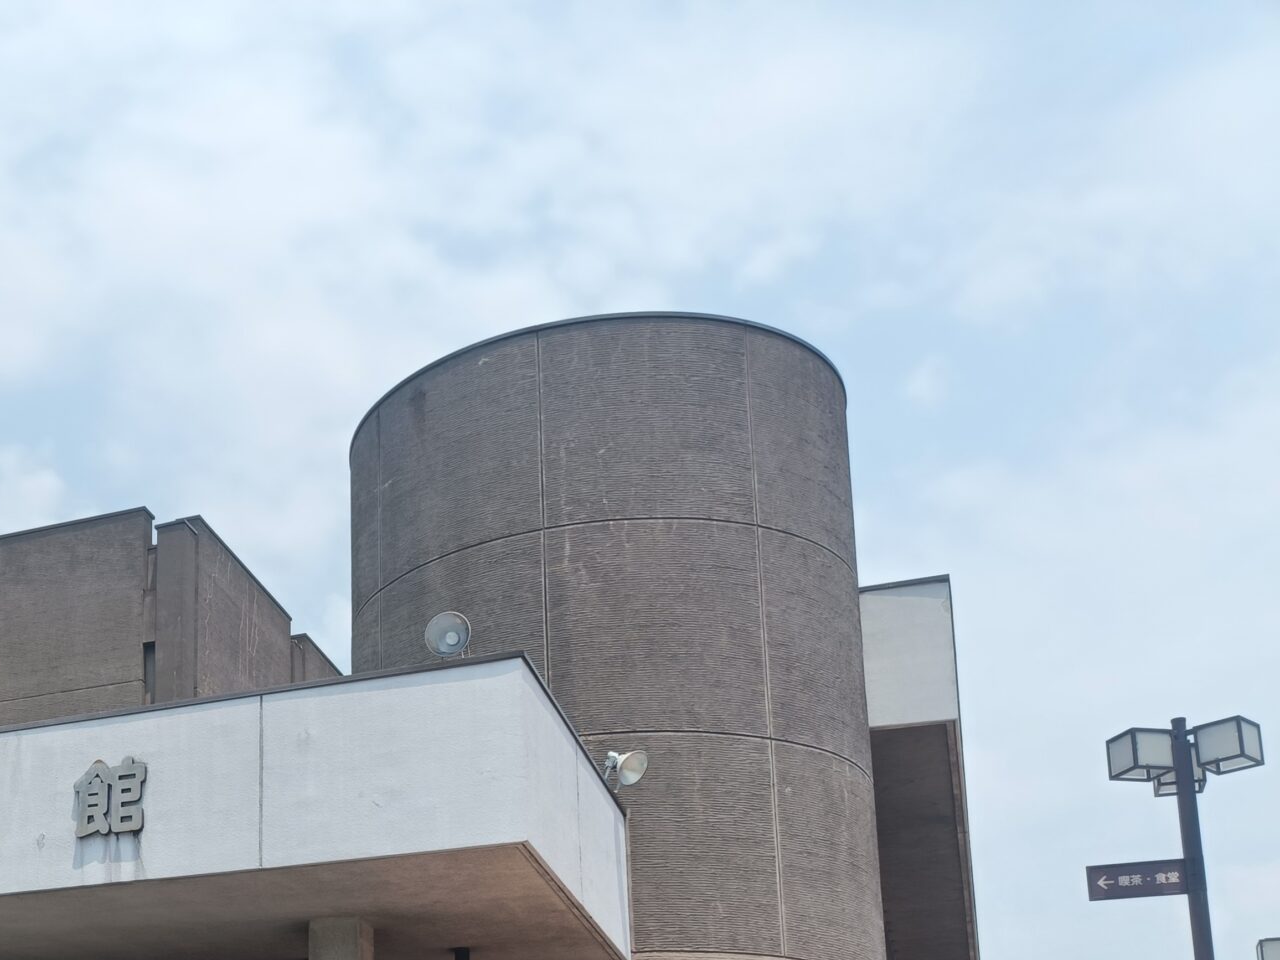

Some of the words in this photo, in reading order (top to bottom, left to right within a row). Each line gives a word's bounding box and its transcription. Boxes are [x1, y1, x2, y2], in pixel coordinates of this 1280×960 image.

[1118, 871, 1180, 887] 喫茶・食堂
